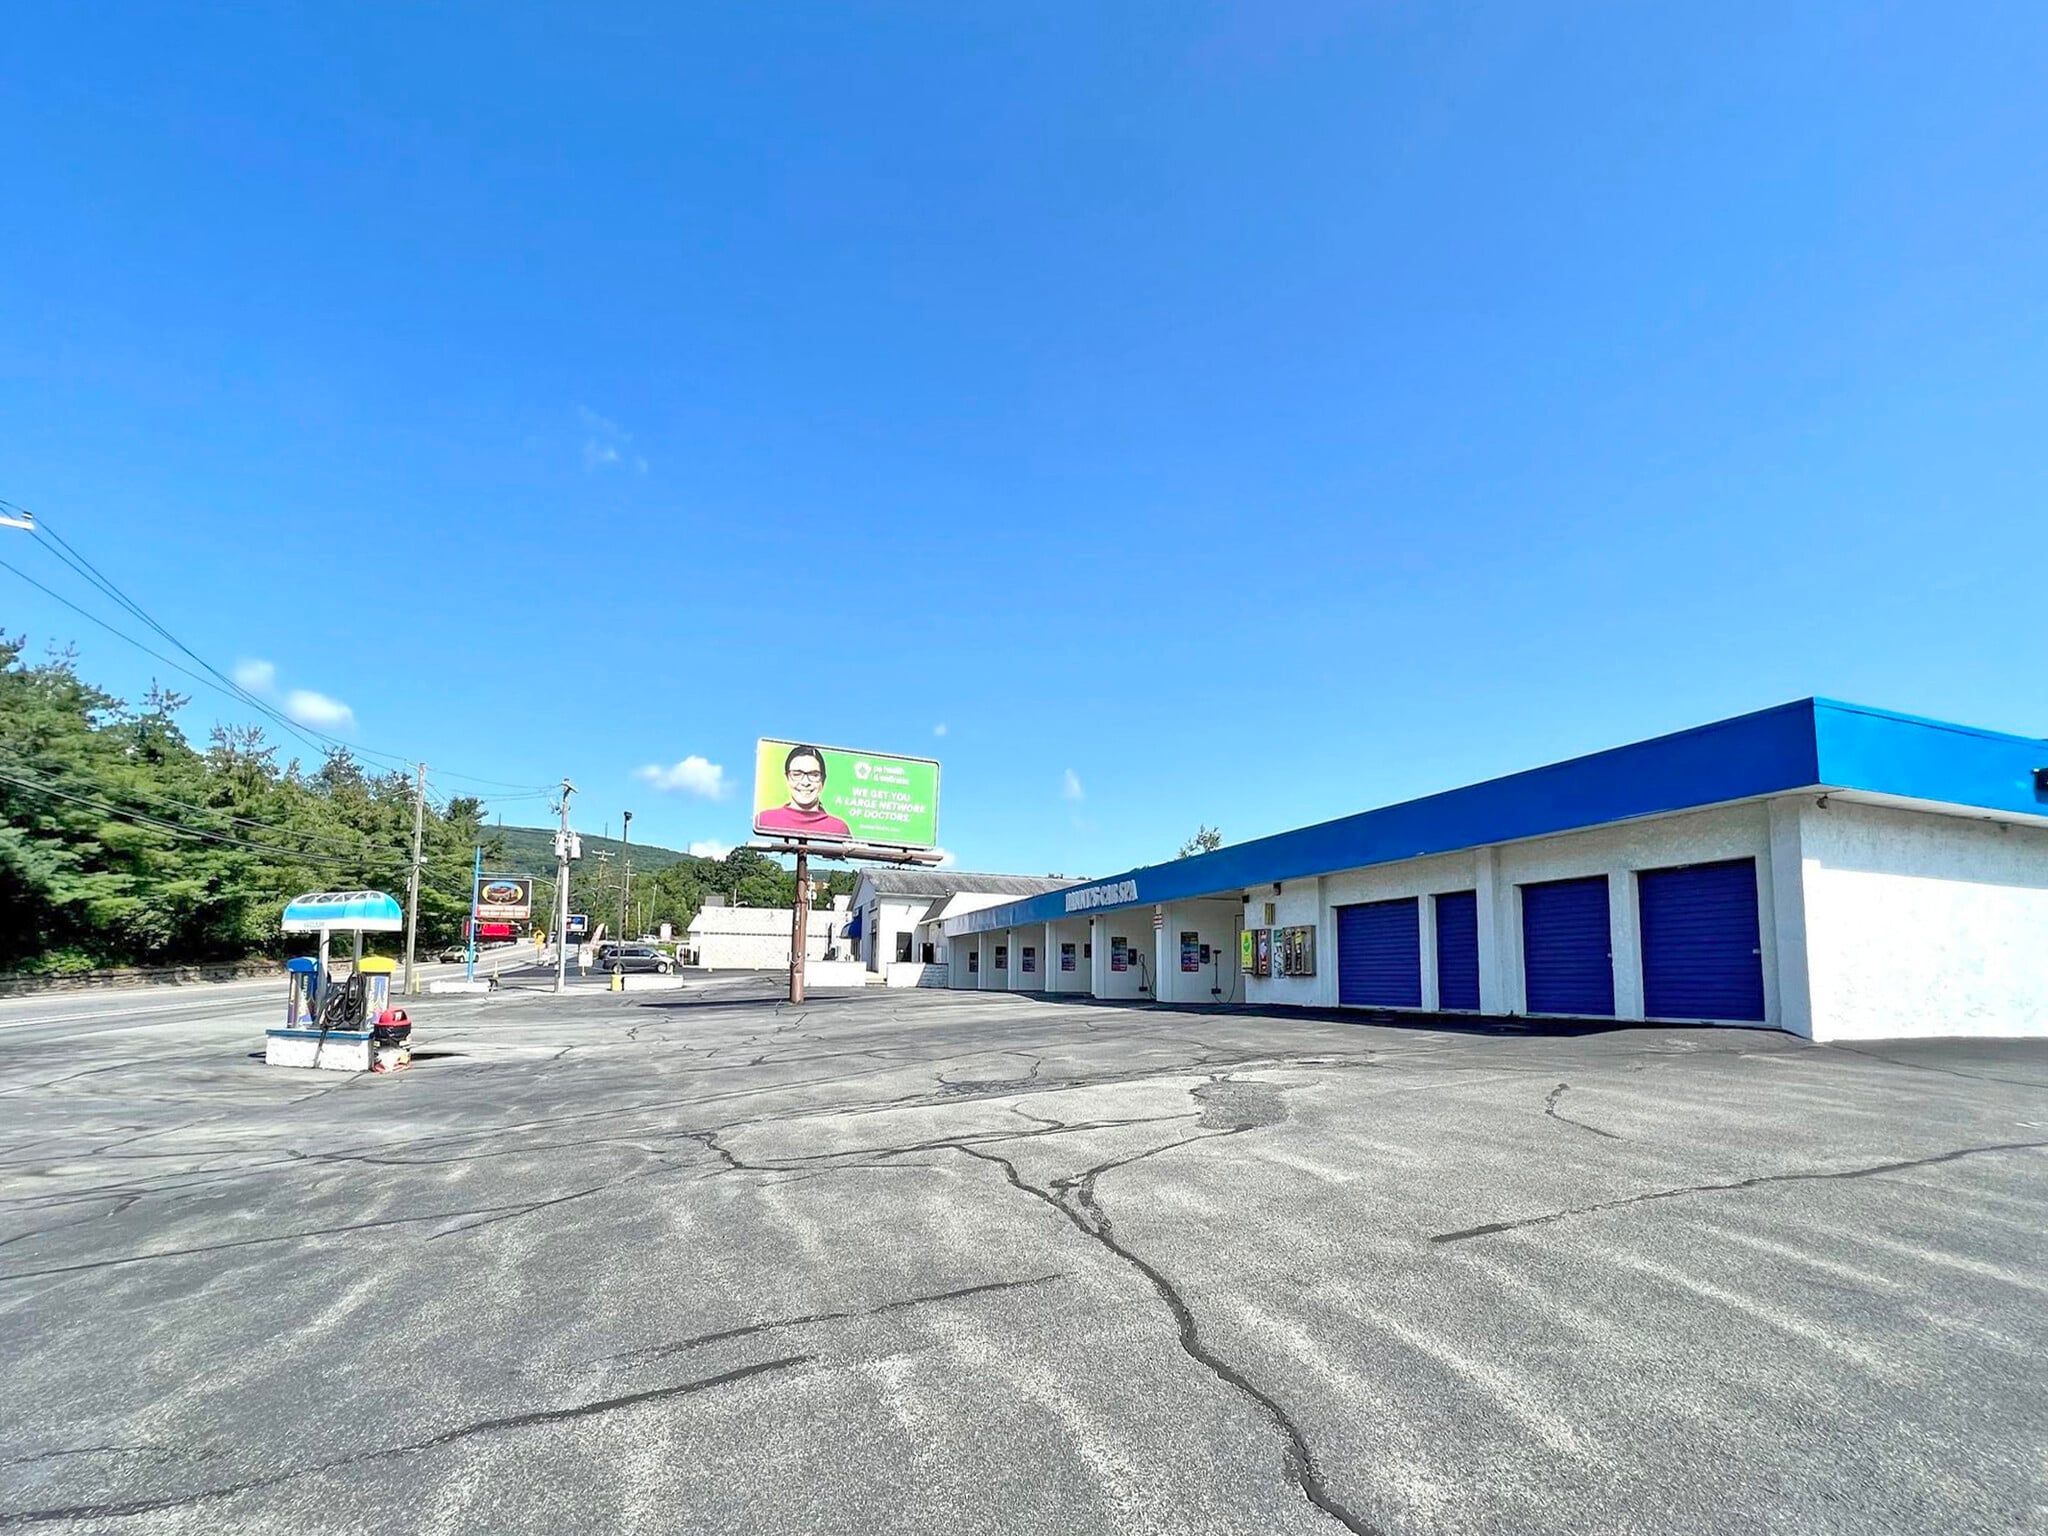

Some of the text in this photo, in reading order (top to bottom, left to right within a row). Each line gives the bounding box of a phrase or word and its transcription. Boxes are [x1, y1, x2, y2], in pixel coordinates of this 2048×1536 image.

[852, 787, 911, 801] WE GET YOU
[834, 795, 925, 812] A LARGE NETWORK
[849, 808, 862, 817] OF
